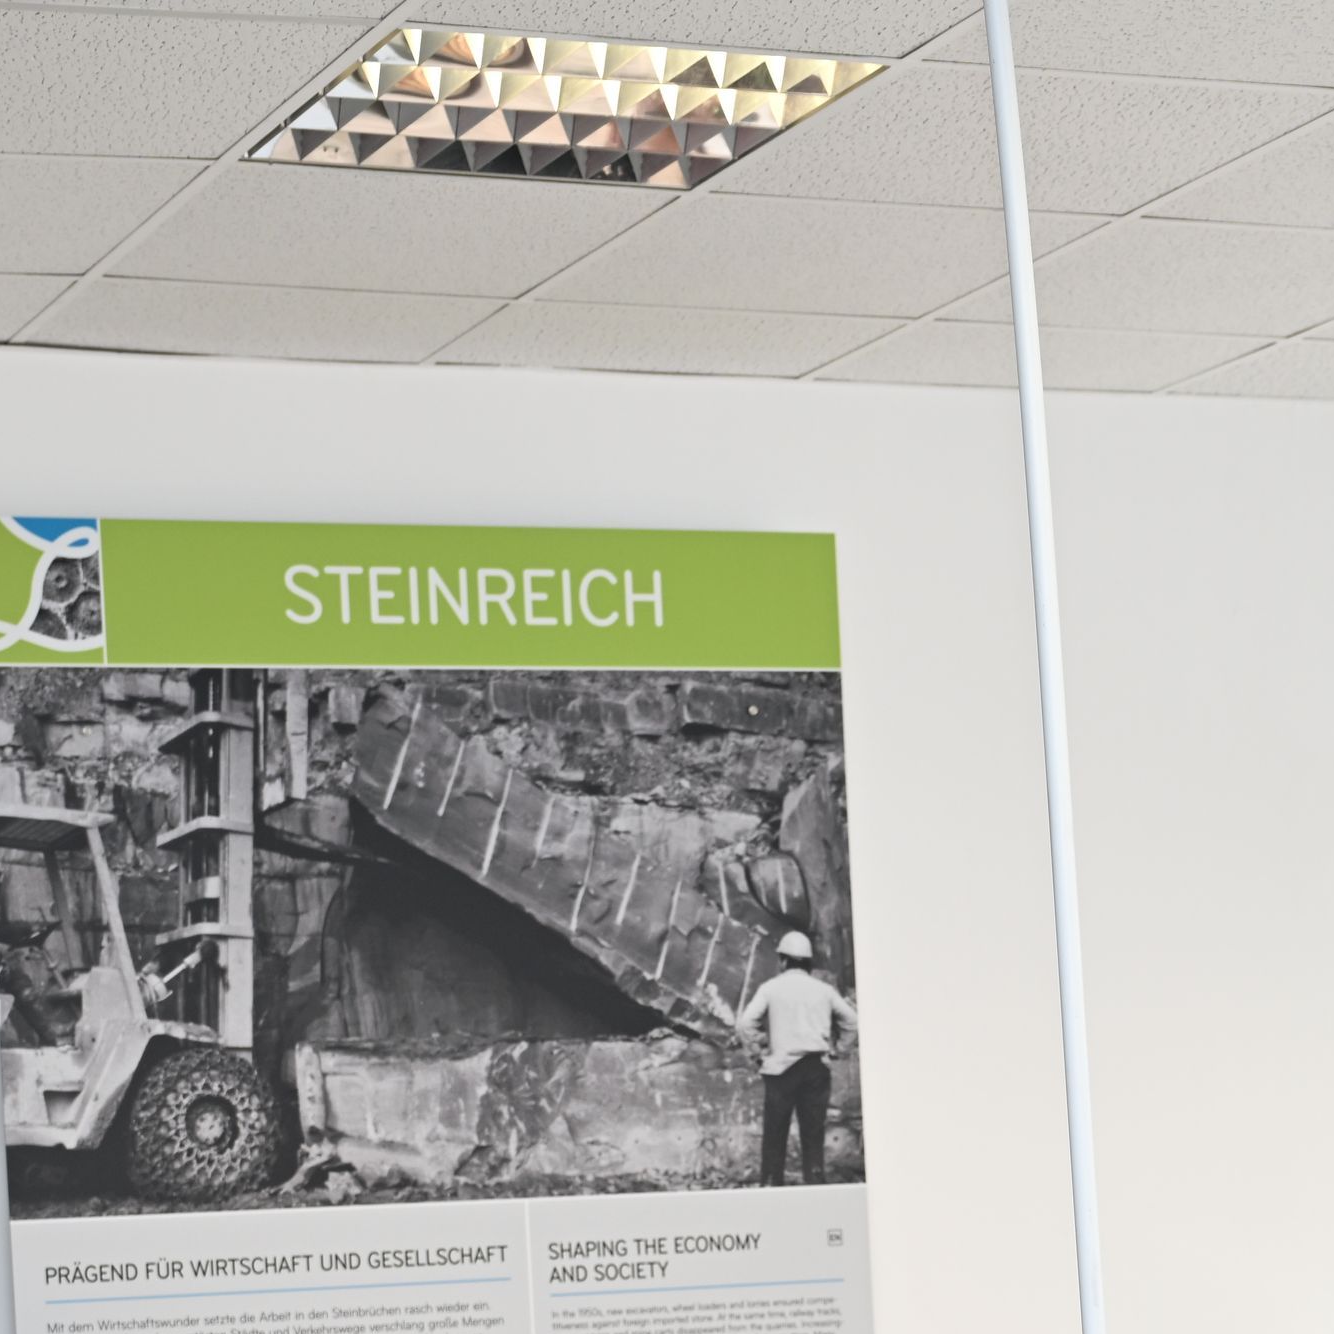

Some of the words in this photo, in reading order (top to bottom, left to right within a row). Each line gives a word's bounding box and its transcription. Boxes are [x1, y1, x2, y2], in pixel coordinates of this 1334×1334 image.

[284, 564, 664, 627] STEINREICH
[548, 1239, 628, 1261] SHAPING
[633, 1237, 668, 1255] THE
[673, 1233, 761, 1255] ECONOMY
[44, 1261, 139, 1285] PRÄGEND
[145, 1257, 184, 1280] FÜR
[189, 1254, 314, 1278] WIRTSCHAFT
[319, 1252, 362, 1272] UND
[367, 1244, 508, 1270] GESELLSCHAFT
[549, 1264, 588, 1284] AND
[593, 1261, 669, 1282] SOCIETY
